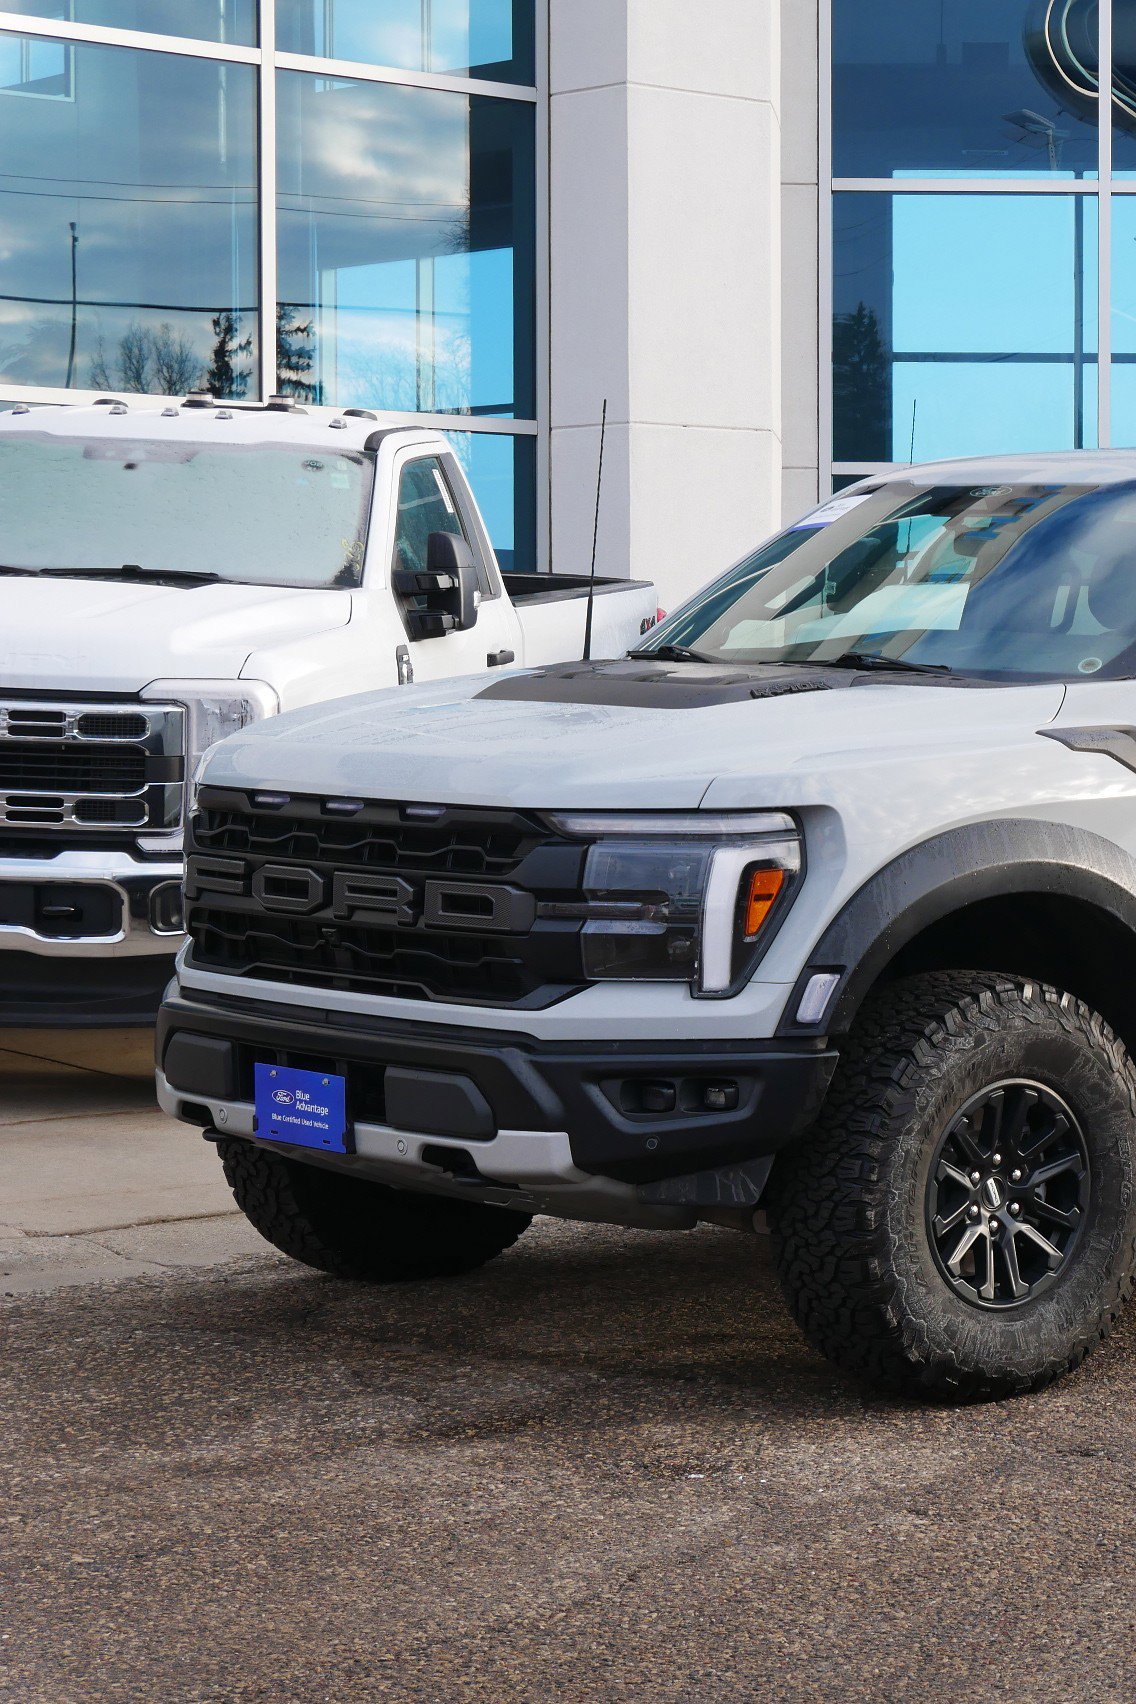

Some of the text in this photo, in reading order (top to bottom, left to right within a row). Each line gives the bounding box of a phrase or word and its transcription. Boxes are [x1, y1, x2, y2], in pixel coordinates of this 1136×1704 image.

[186, 855, 538, 936] FORD
[295, 1090, 310, 1101] Blue
[295, 1101, 329, 1116] Advantage
[271, 1113, 329, 1130] Blue Certified Used Vehicle
